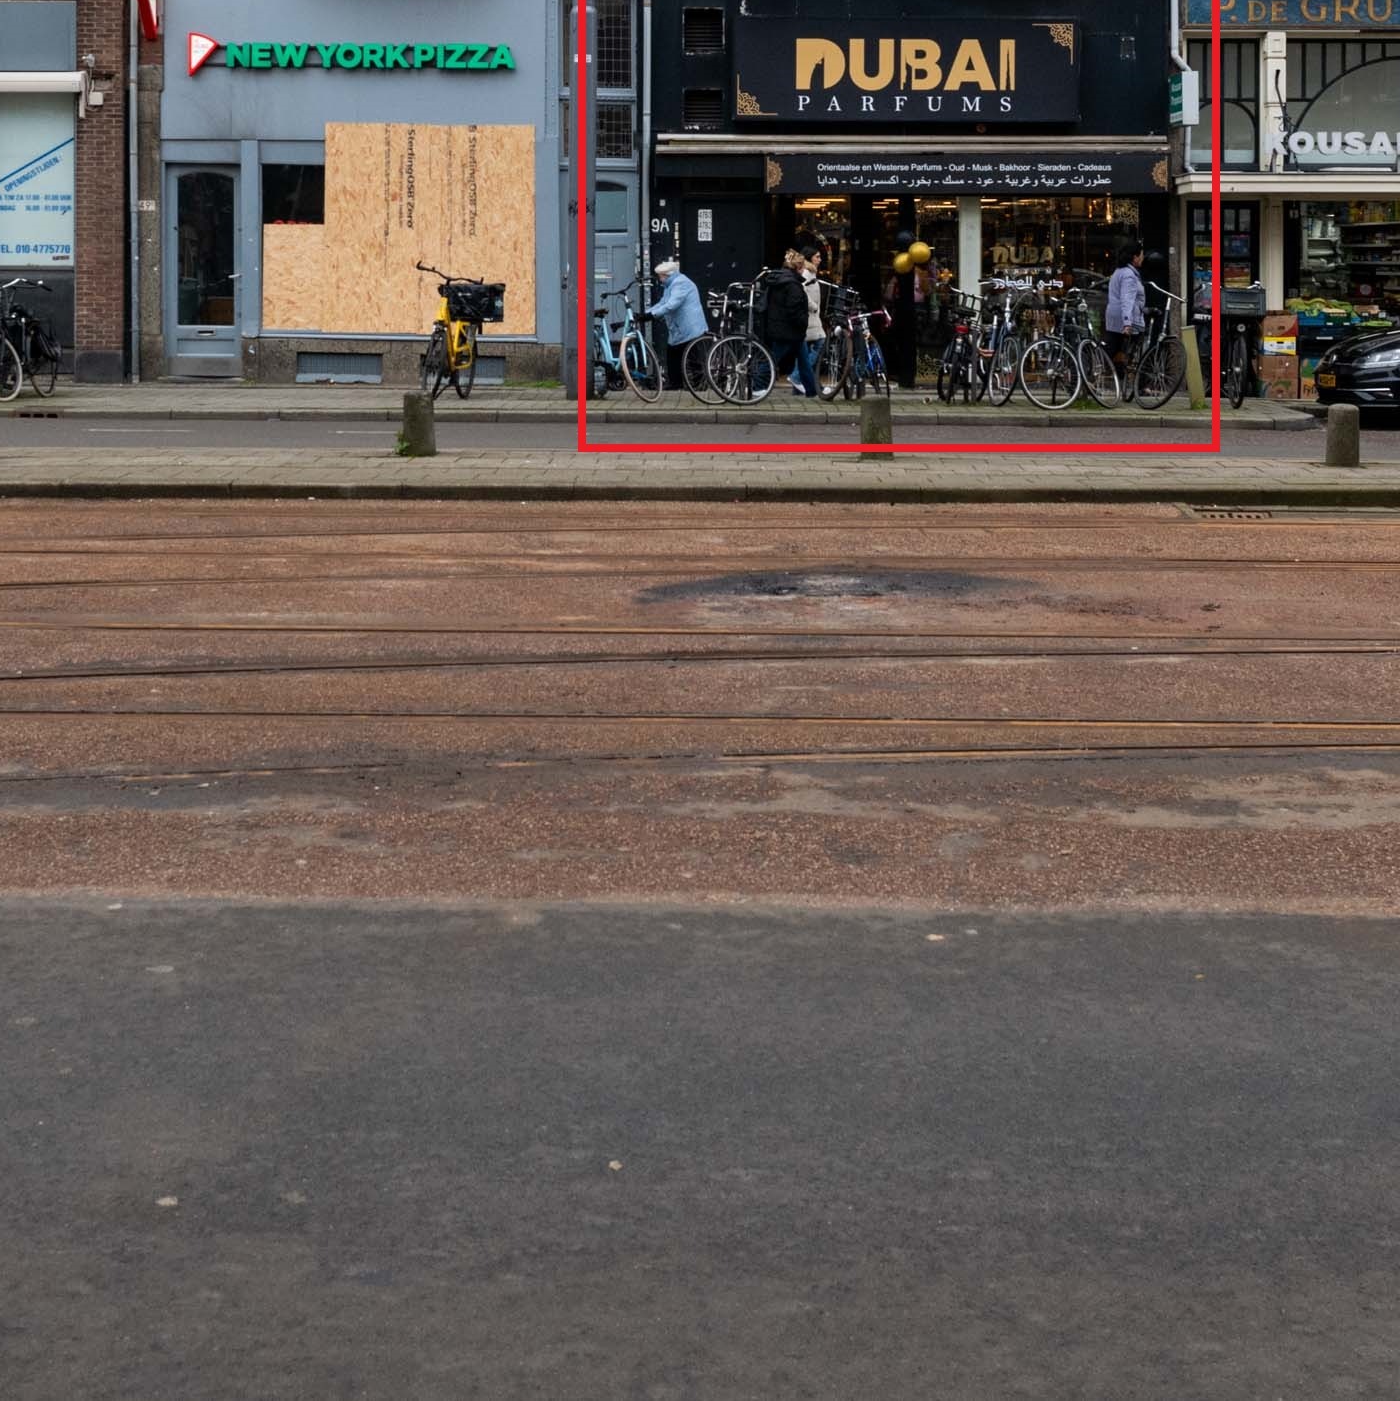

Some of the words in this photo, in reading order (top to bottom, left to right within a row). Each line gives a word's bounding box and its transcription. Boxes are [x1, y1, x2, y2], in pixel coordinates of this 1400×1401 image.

[1248, 0, 1288, 22] DE
[225, 43, 309, 68] NEW
[315, 42, 412, 70] YORK
[413, 43, 516, 70] PIZZA
[795, 38, 1016, 91] DUBAI
[797, 96, 1013, 113] PARFUMS
[817, 163, 860, 172] Orientaalse
[873, 163, 909, 172] Westerse
[911, 163, 943, 172] Parfums
[948, 163, 965, 172] Oud
[972, 163, 993, 172] Musk
[999, 163, 1031, 172] Bakhoor
[1037, 163, 1072, 172] Sieraden
[1077, 163, 1112, 172] Cadeaus
